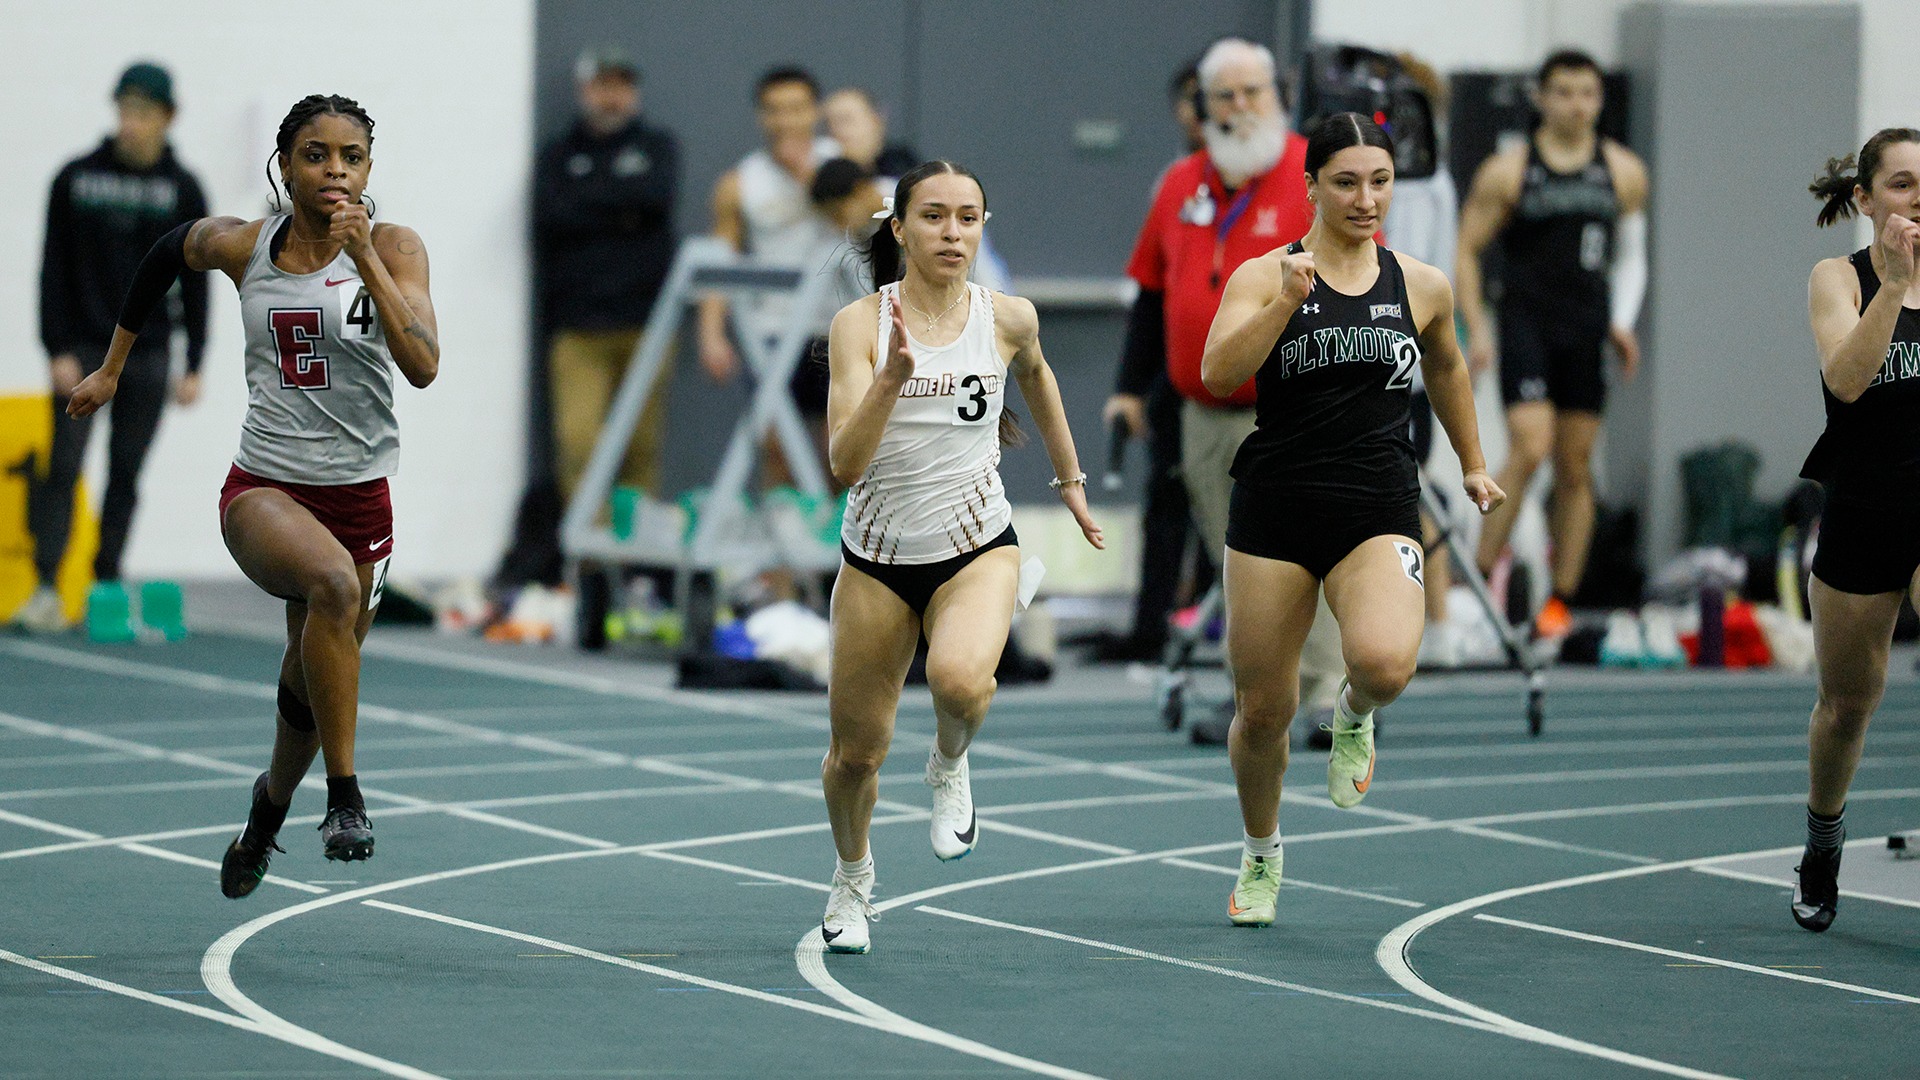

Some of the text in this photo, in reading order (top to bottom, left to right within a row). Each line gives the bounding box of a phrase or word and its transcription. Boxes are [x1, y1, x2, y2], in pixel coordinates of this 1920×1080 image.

[346, 286, 374, 335] 4
[268, 307, 331, 390] E
[1281, 326, 1410, 379] PLYMOU
[1390, 343, 1417, 386] 2
[899, 377, 939, 398] ODE
[957, 374, 988, 422] 3
[1400, 545, 1423, 587] 2
